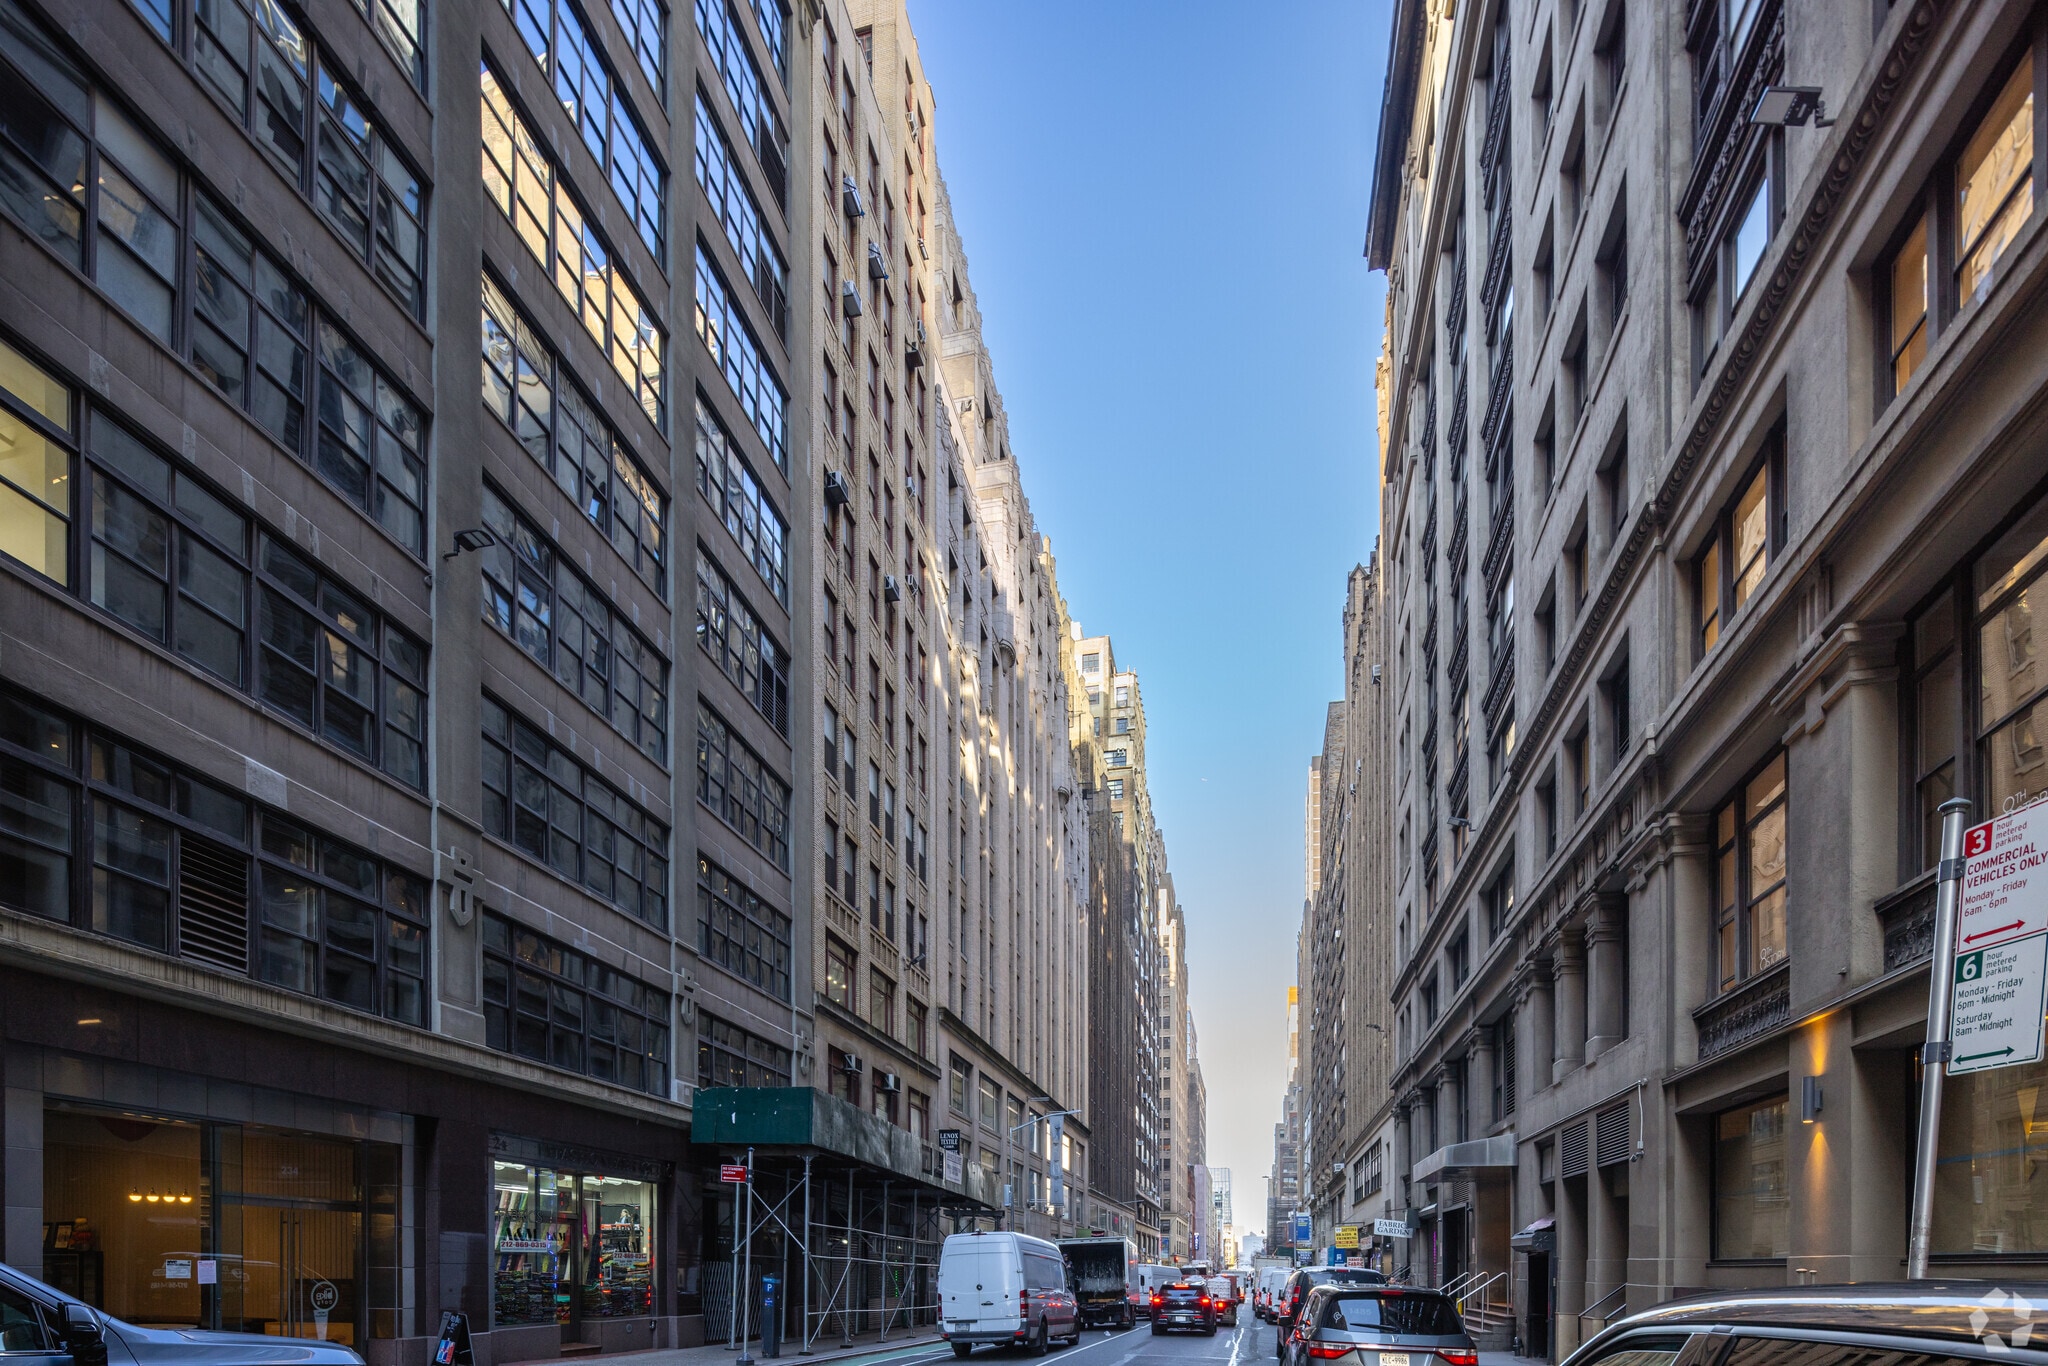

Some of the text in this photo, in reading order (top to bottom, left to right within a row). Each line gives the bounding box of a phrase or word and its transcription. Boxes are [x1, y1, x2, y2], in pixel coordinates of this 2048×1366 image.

[1995, 821, 2028, 840] metered
[1997, 820, 2013, 831] hour
[1971, 829, 1986, 854] 3
[1995, 833, 2023, 850] parking
[1967, 842, 2036, 876] COMMERCIAL
[1966, 851, 2048, 888] VEHICLES ONLY
[1965, 889, 1995, 905] Monday
[2002, 878, 2028, 893] Friday
[1964, 904, 1982, 917] 6am
[1989, 896, 2008, 909] 6pm
[1986, 951, 2003, 961] hour
[1986, 954, 2017, 969] metered
[1962, 955, 1977, 980] 6
[1985, 964, 2013, 978] parking
[1958, 985, 1989, 999] Monday
[1997, 977, 2024, 990] Friday
[1957, 999, 1975, 1011] 6pm
[1981, 989, 2015, 1005] Midnight
[1955, 1027, 1972, 1037] 8am
[1979, 1017, 2013, 1032] Midnight
[1956, 1012, 1993, 1026] Saturday
[1377, 1227, 1410, 1235] GARDEN
[1379, 1221, 1407, 1229] FABRIC
[767, 1283, 773, 1292] P
